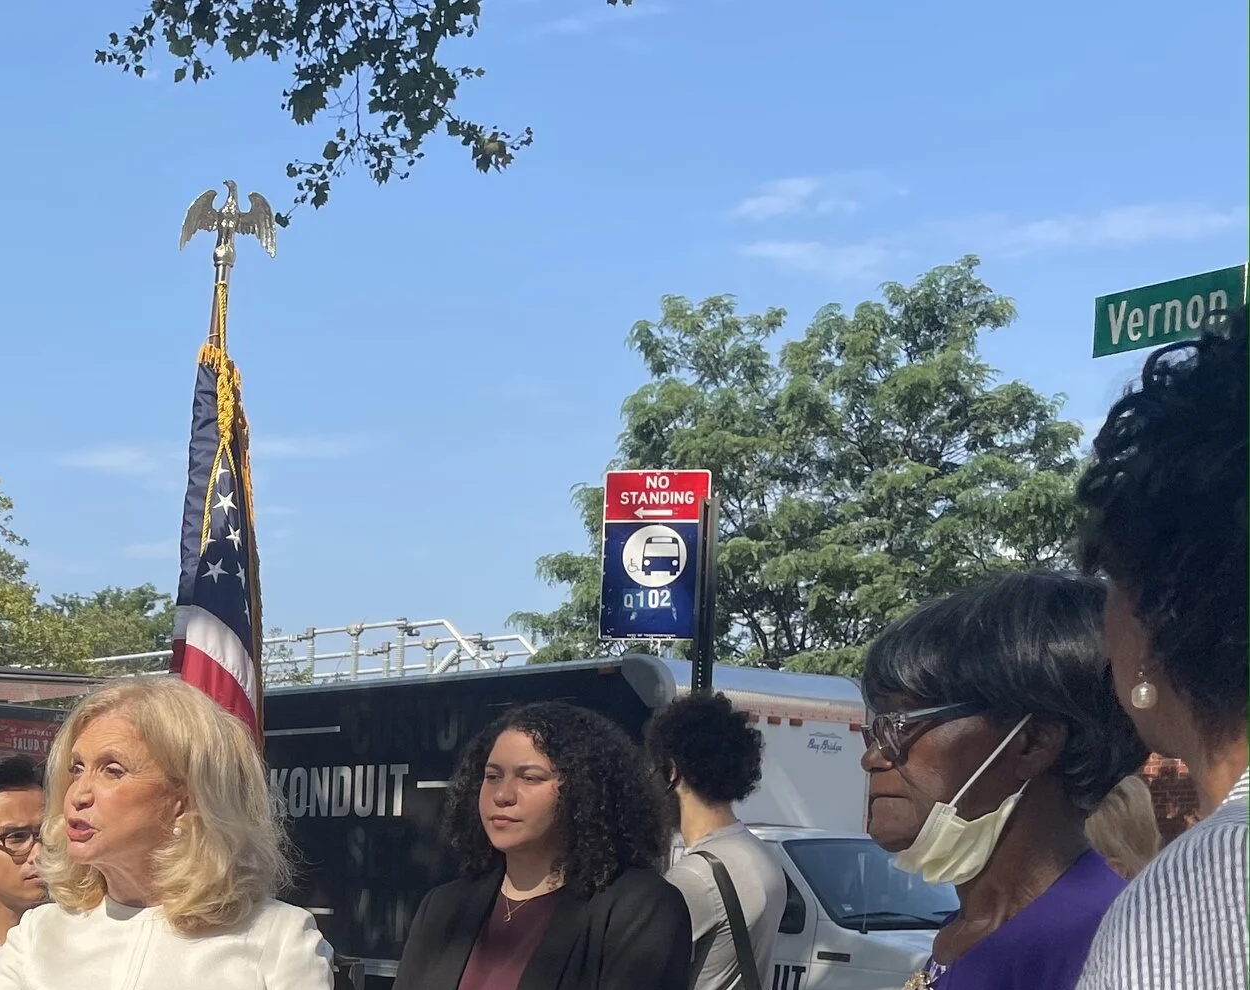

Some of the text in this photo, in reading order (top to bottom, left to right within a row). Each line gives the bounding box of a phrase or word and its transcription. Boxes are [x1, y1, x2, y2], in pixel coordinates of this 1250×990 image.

[1108, 289, 1228, 345] Vernon
[646, 475, 669, 489] NO
[620, 491, 694, 505] STANDING
[624, 589, 671, 609] Q102
[13, 737, 40, 751] SALUD
[270, 763, 409, 818] KONDUIT
